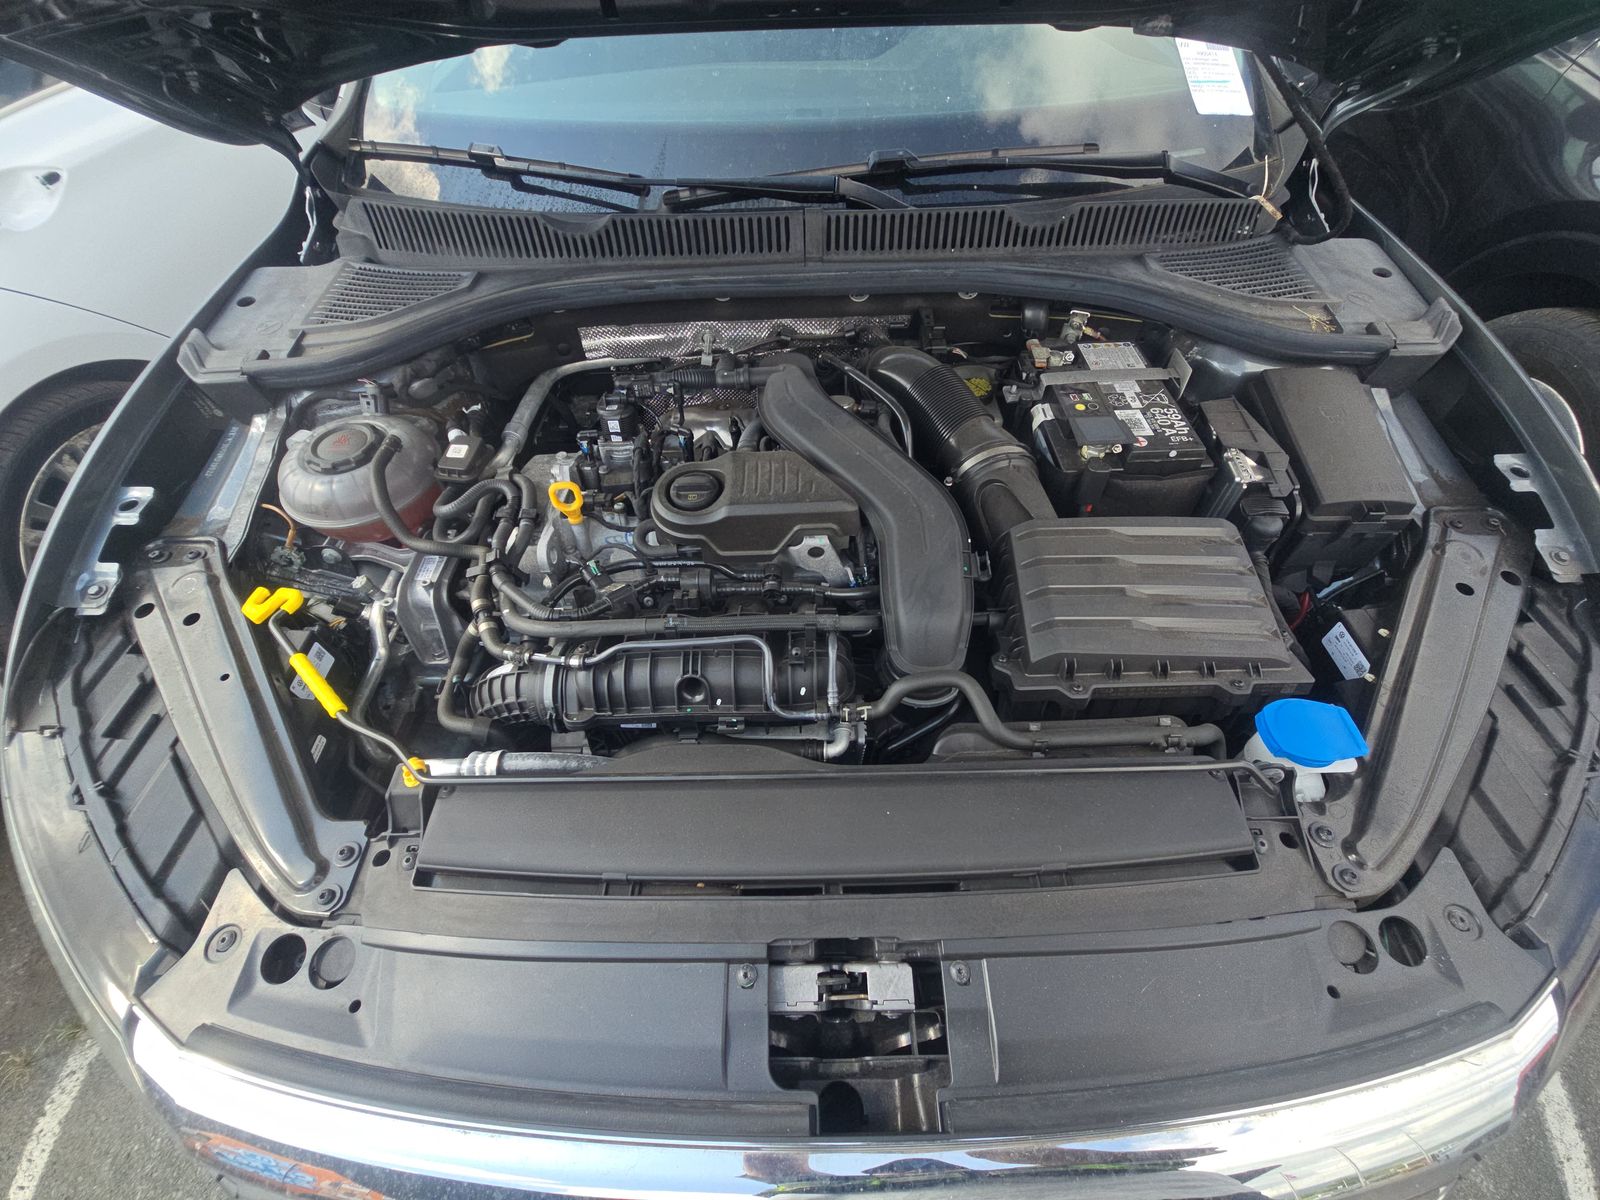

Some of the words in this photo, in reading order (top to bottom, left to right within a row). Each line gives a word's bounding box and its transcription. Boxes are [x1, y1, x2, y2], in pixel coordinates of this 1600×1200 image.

[1150, 407, 1171, 425] 640
[1161, 427, 1177, 436] A
[1164, 408, 1190, 434] 59Ah
